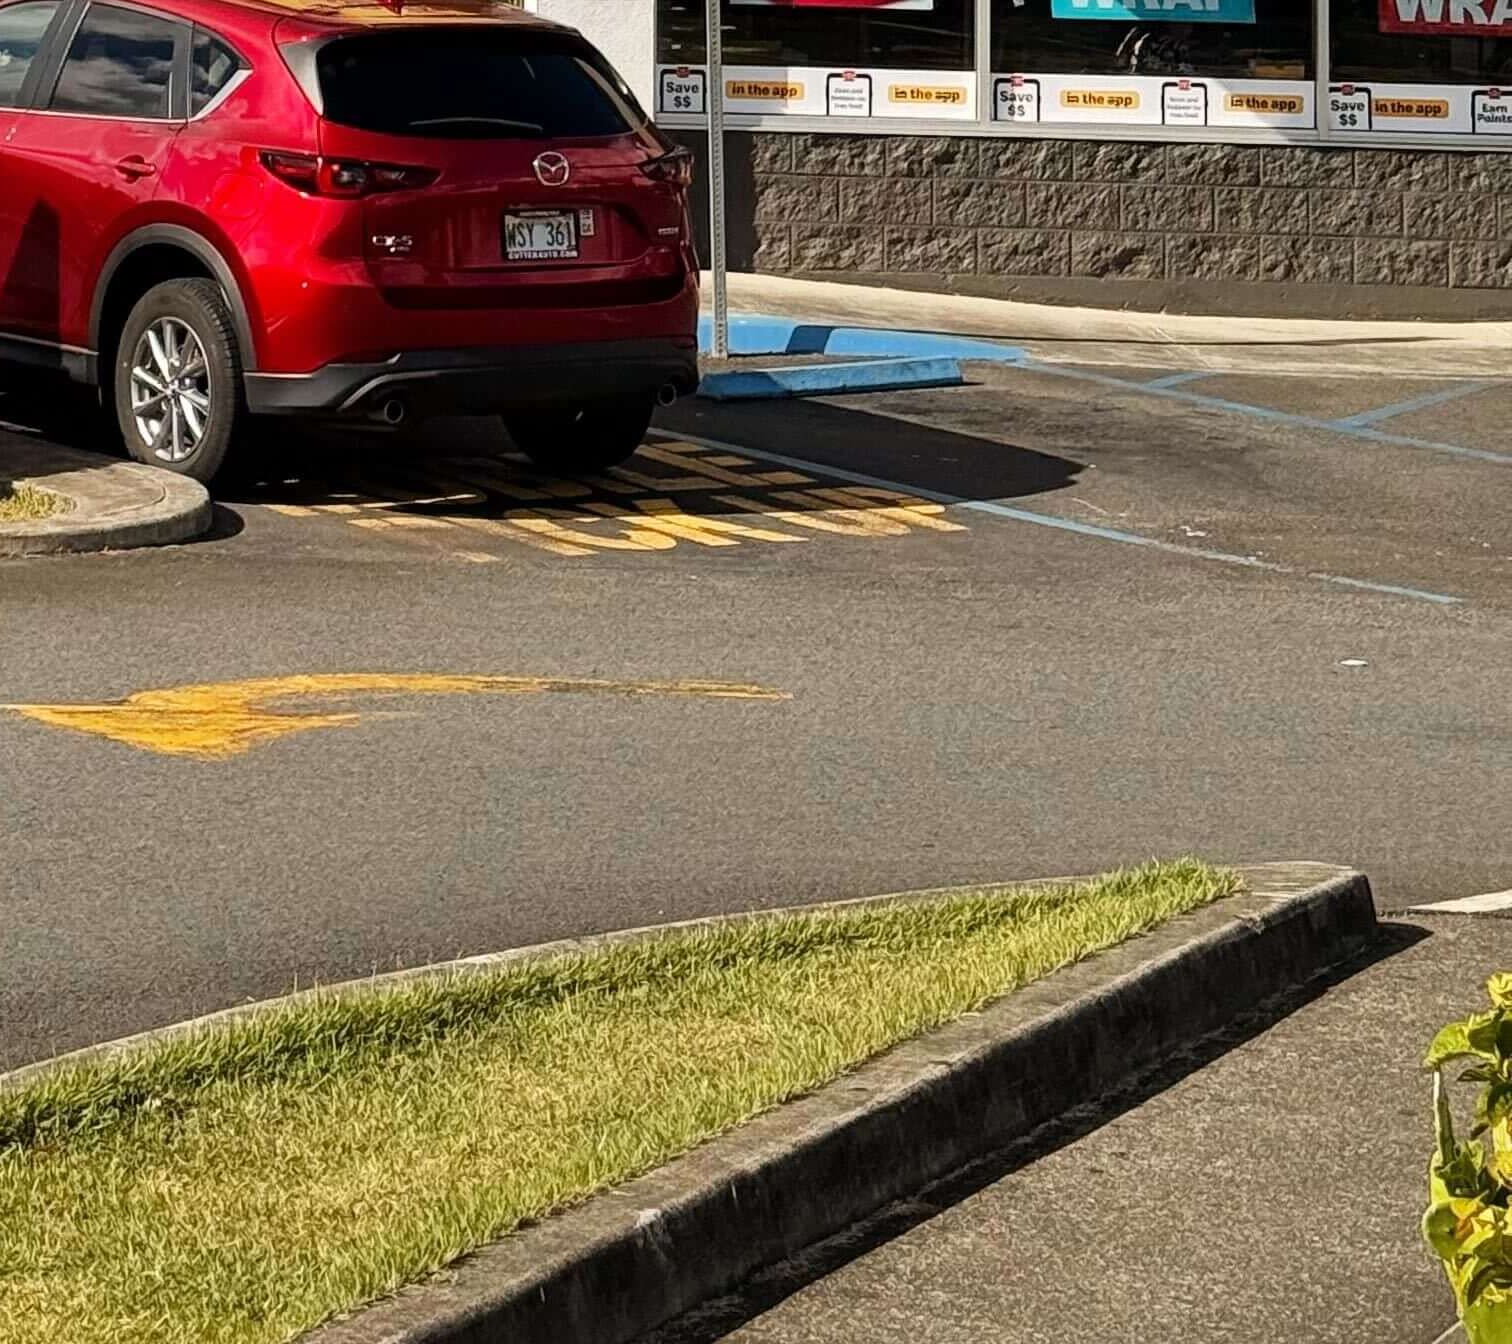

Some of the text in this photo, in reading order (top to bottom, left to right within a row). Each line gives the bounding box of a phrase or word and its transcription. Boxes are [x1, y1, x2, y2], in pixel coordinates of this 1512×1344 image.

[666, 82, 699, 93] Save
[731, 81, 798, 100] in the app
[910, 88, 932, 100] the
[673, 95, 692, 109] $$
[999, 90, 1034, 102] Save
[1082, 92, 1105, 105] the
[1107, 95, 1134, 108] app
[1244, 95, 1268, 109] the
[1270, 98, 1297, 112] app
[1330, 100, 1365, 111] Save
[1375, 100, 1442, 117] in the app
[1482, 103, 1508, 113] Earn
[1338, 113, 1358, 126] $$
[506, 222, 534, 248] WSY
[545, 222, 572, 248] 361
